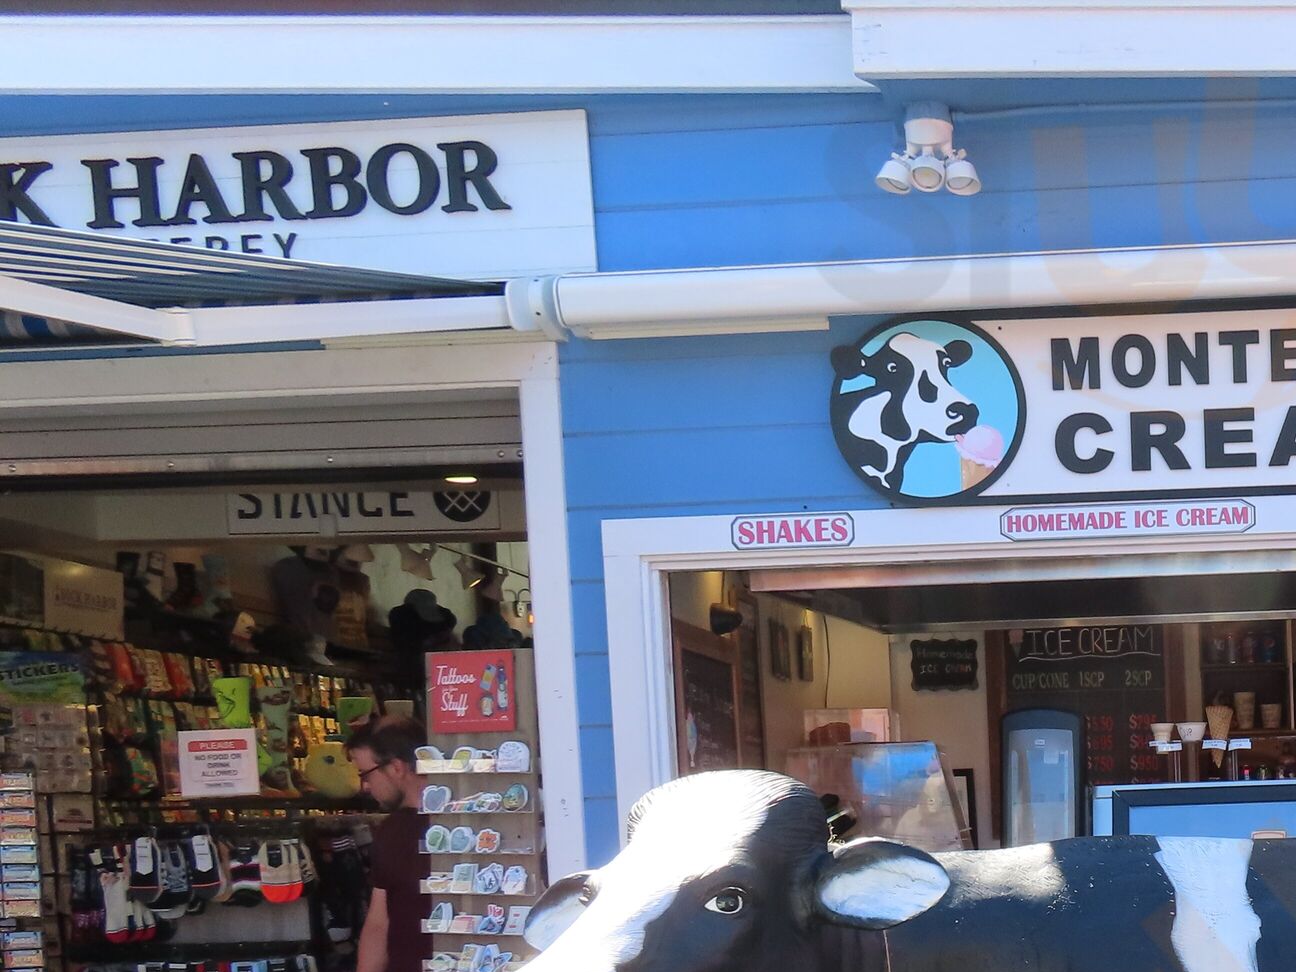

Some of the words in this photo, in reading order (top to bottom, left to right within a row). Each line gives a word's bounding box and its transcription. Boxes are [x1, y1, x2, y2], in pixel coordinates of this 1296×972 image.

[81, 140, 511, 229] HARBOR
[238, 491, 415, 519] STANCE
[738, 517, 850, 546] SHAKES
[1006, 510, 1128, 534] HOMEMADE
[1133, 509, 1171, 530] ICE
[1175, 505, 1251, 528] CREAM
[1026, 629, 1072, 656] ICE
[1078, 626, 1155, 655] CREAM
[0, 663, 80, 681] STICKERS
[436, 665, 476, 685] Tattoos
[440, 691, 469, 717] Stuff
[199, 742, 236, 750] PLEASE
[207, 753, 229, 761] FOOD
[201, 769, 239, 778] ALLOWED
